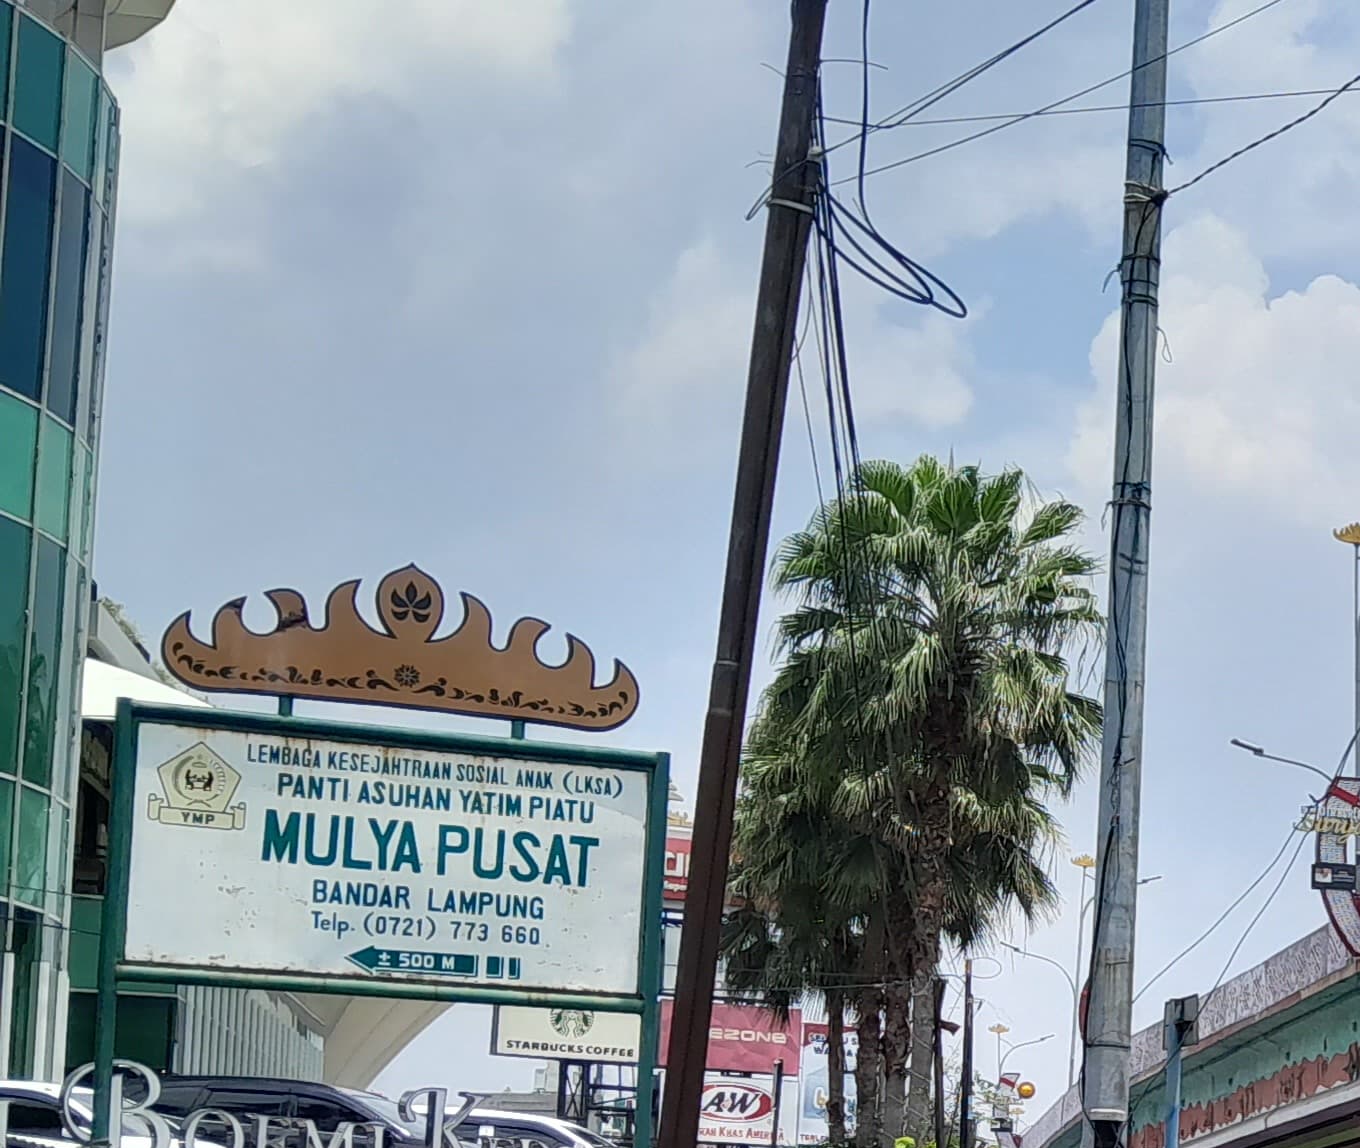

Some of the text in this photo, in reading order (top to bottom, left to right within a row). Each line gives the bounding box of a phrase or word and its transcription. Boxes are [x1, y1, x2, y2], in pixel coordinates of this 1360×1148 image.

[247, 743, 623, 799] LEMBAGA KESEJAHTRAAN SOSIAL ANAK (LKSA)
[277, 772, 594, 824] PANTI ASUHAN YATIM PIATU
[181, 811, 216, 825] YMP
[261, 809, 421, 874] MULYA
[436, 823, 600, 888] PUSAT
[312, 879, 544, 920] BANDAR LAMPUNG
[311, 910, 540, 946] Telp. (0721) 773 660
[399, 953, 434, 970] 500
[441, 955, 455, 970] M
[506, 1039, 635, 1057] STARBUCKS COFFEE
